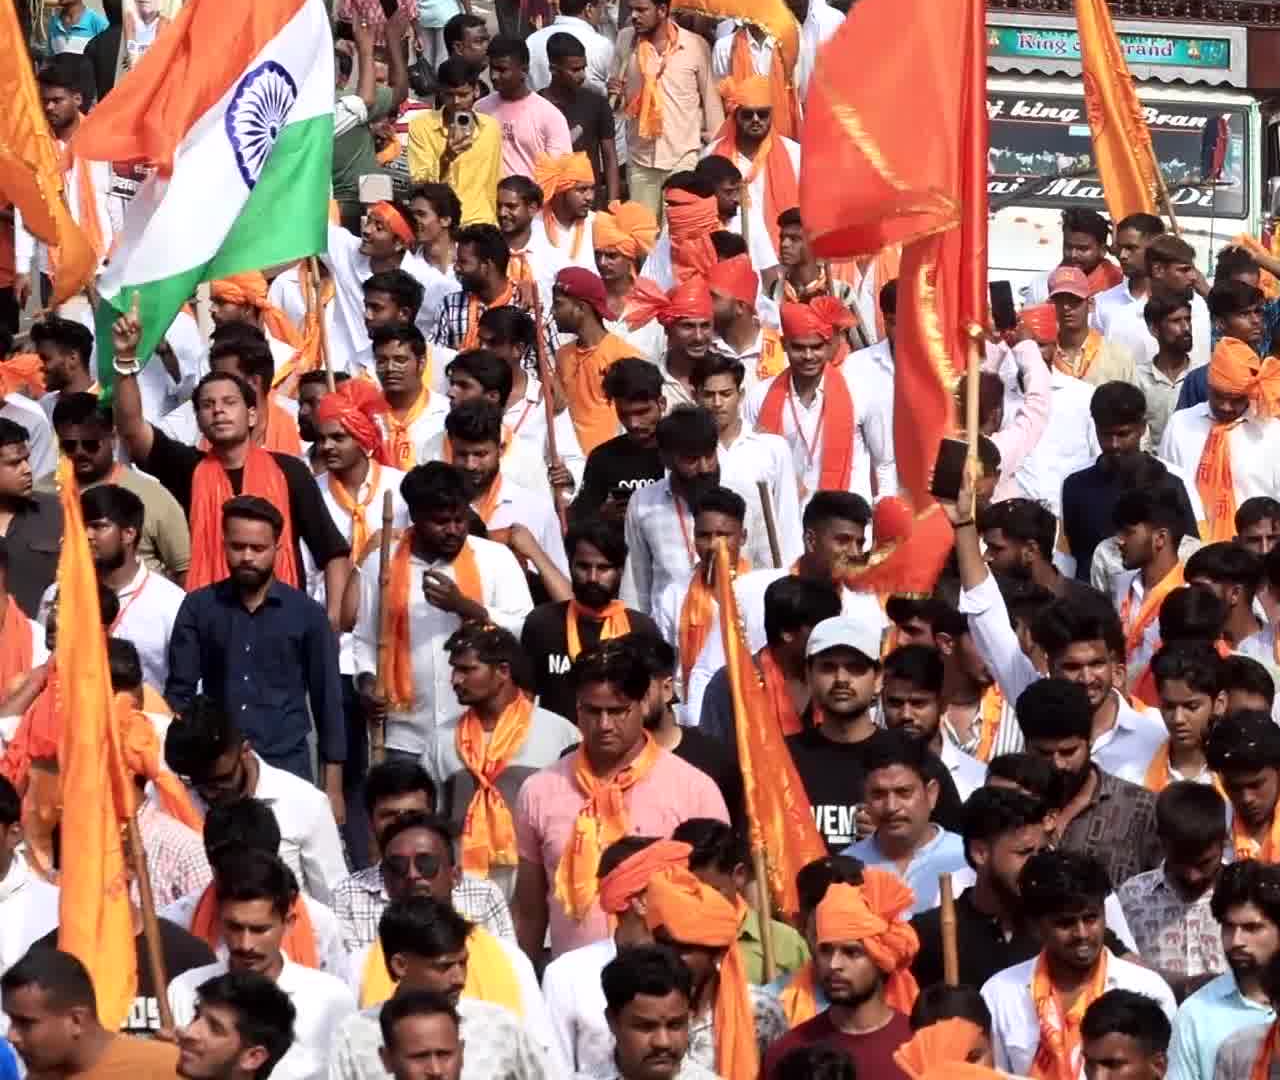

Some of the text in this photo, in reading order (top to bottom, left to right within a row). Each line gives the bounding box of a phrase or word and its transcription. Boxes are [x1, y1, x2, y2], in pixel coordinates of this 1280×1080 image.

[1121, 41, 1175, 58] rand
[1010, 100, 1081, 122] king
[1141, 107, 1233, 128] Bran
[987, 178, 1215, 207] ai Ma Di
